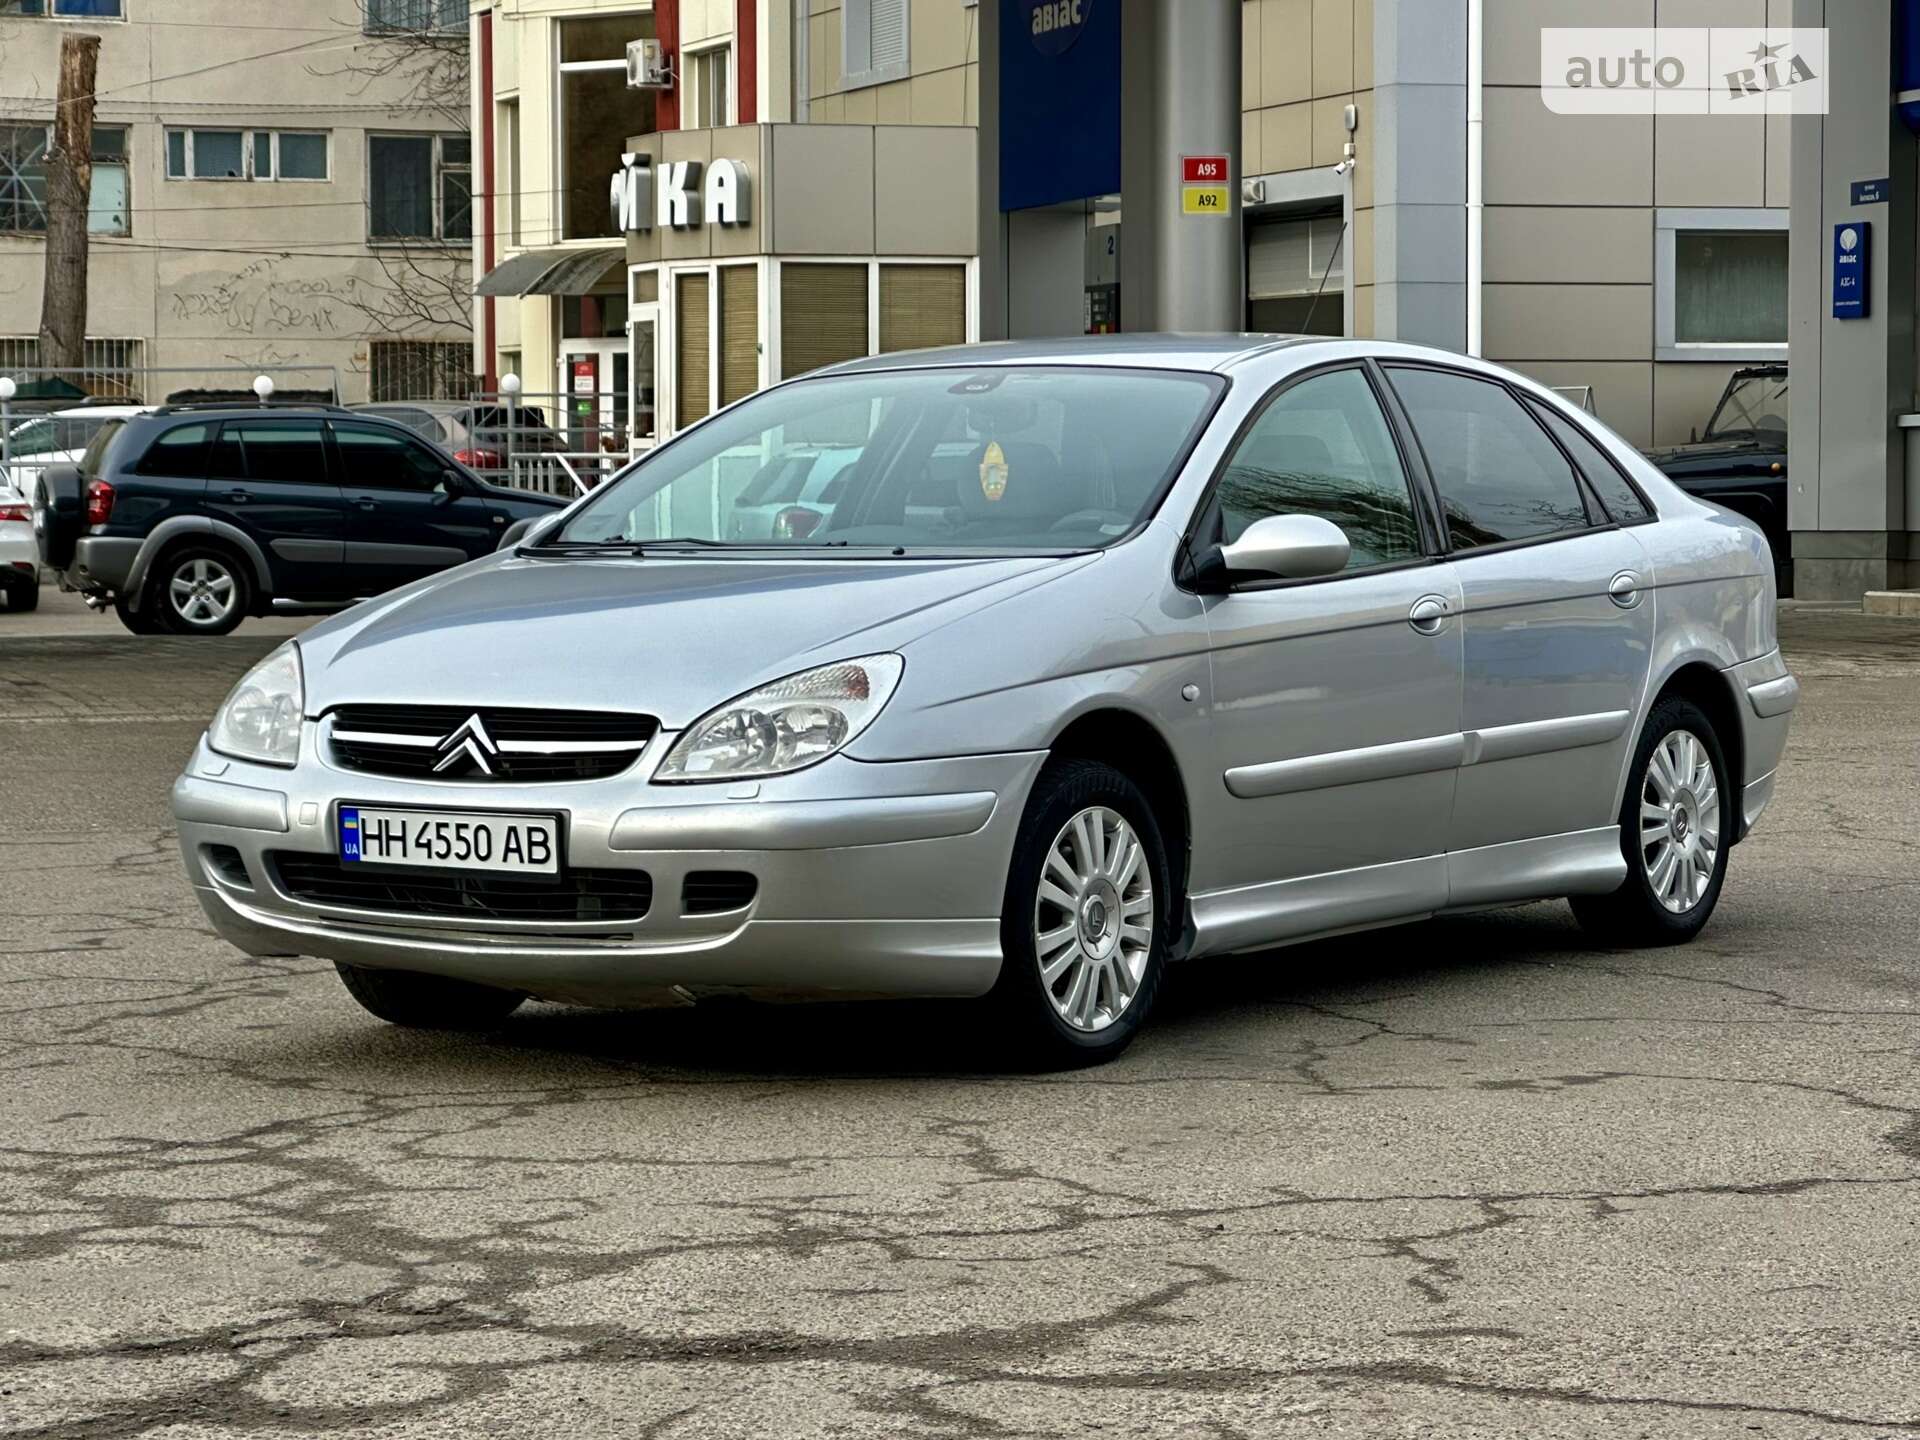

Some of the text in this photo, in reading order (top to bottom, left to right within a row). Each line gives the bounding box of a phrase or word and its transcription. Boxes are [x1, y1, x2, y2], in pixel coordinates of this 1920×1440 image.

[1197, 163, 1217, 177] A95
[610, 151, 751, 232] ЙКА
[1198, 194, 1218, 207] A92
[1107, 235, 1115, 255] 2
[344, 843, 359, 855] UA
[361, 817, 551, 865] HH 4550 AB
